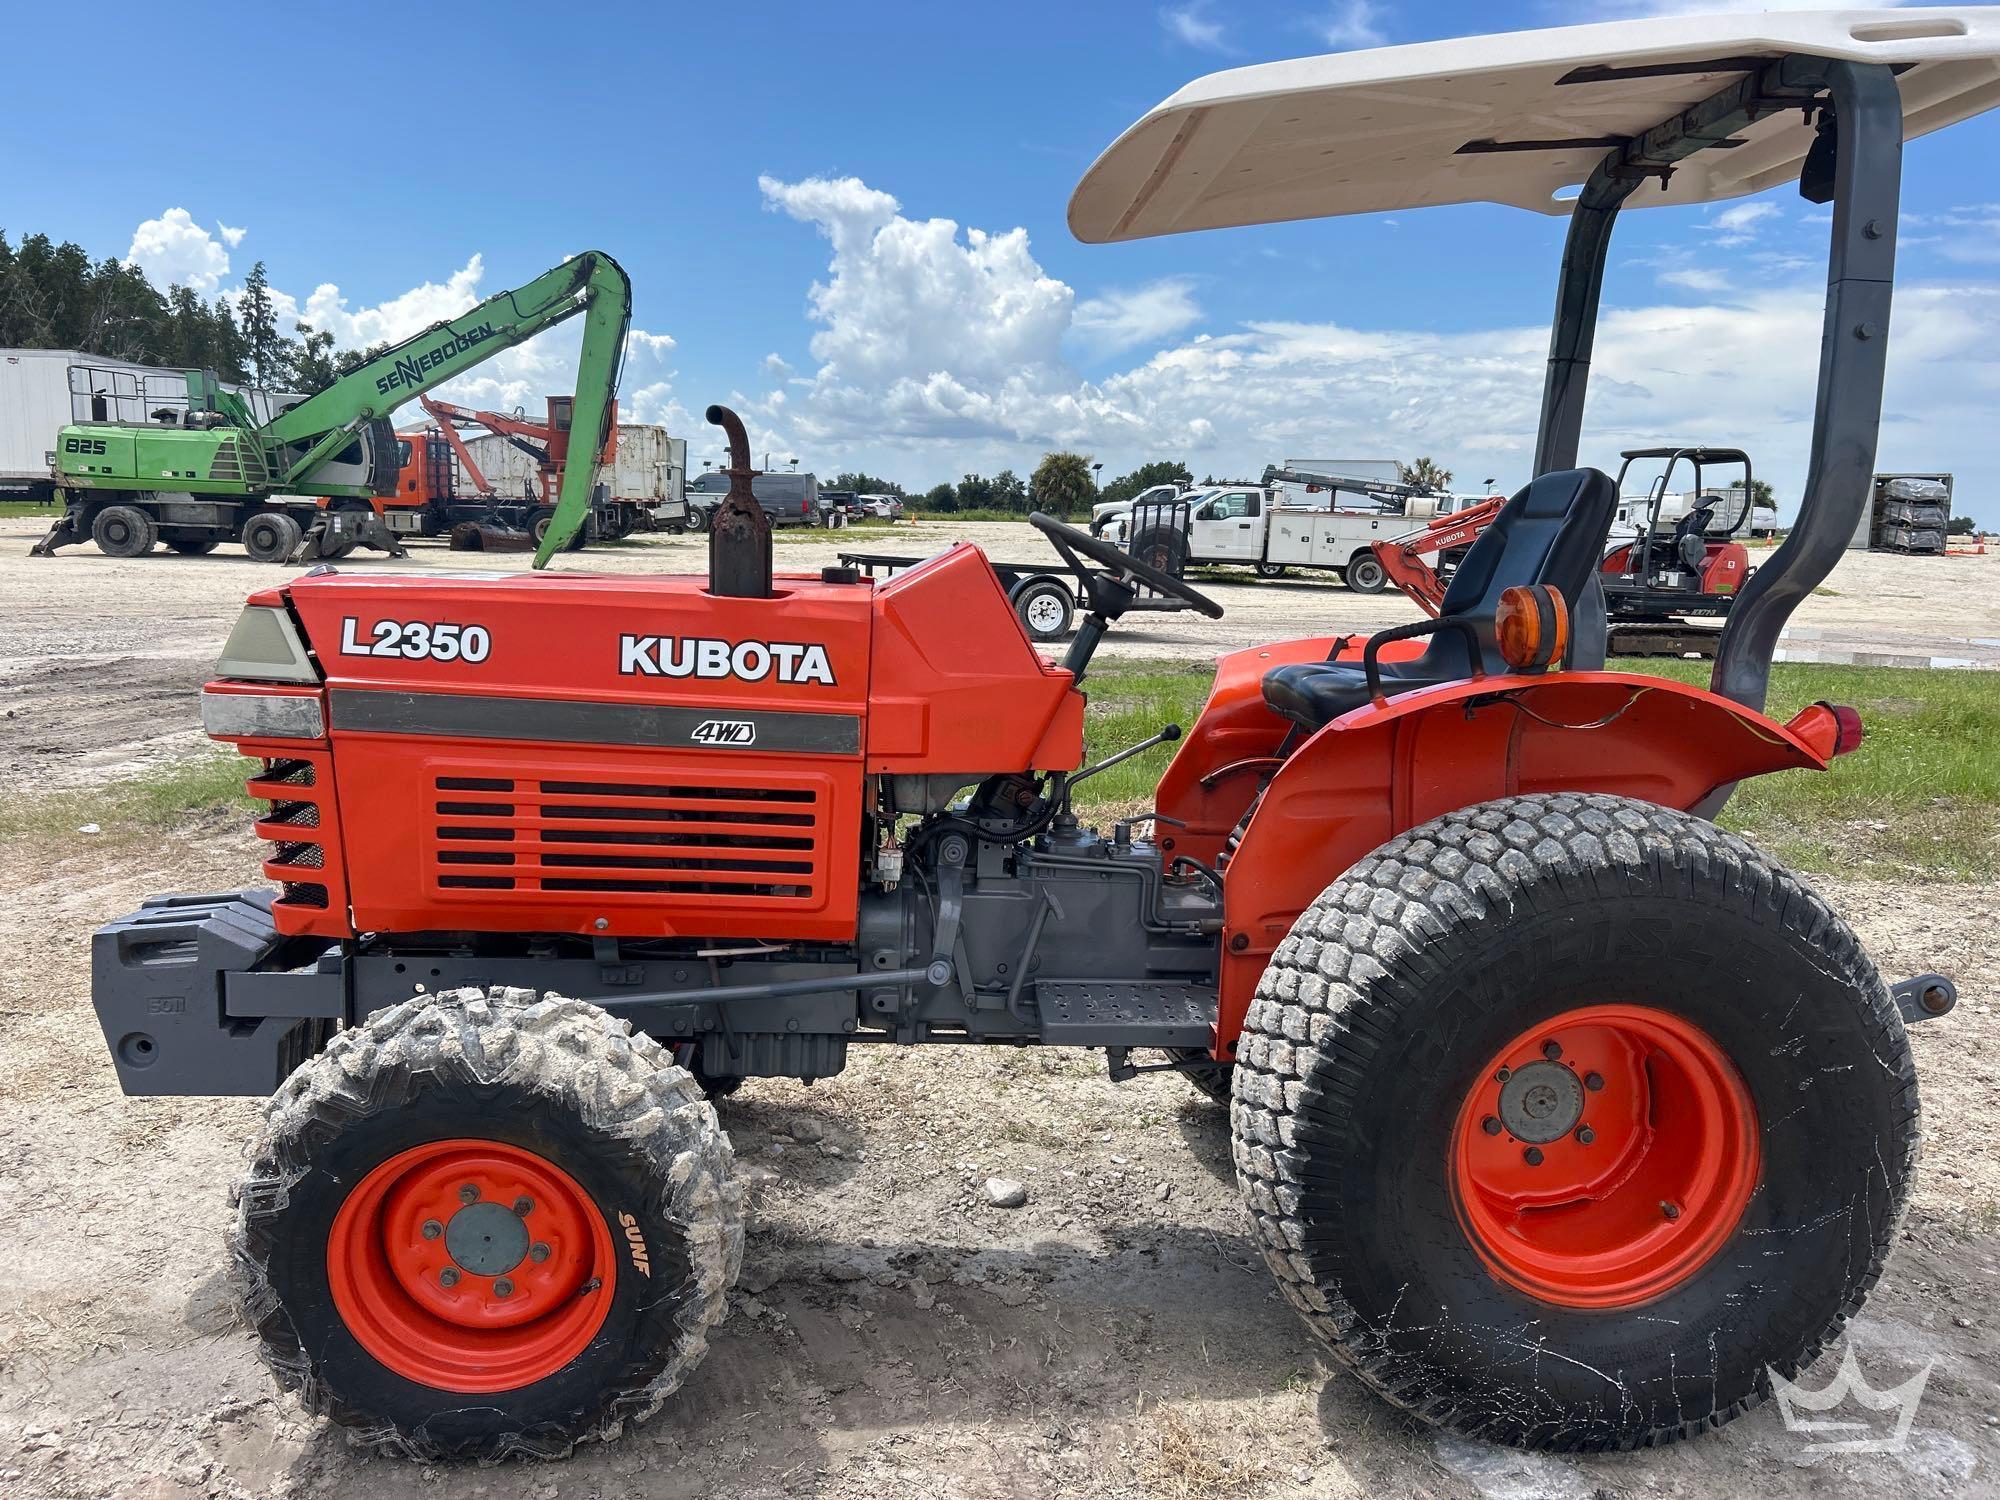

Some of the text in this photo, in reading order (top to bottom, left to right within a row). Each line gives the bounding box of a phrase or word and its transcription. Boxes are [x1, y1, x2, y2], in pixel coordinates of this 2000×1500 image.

[376, 322, 496, 395] SENNEBOGEN
[65, 438, 107, 456] 825
[1435, 531, 1466, 546] KUBOTA
[339, 616, 491, 664] L2350
[618, 632, 838, 686] KUBOTA
[691, 720, 756, 745] 4WD
[618, 1210, 651, 1280] SUNF
